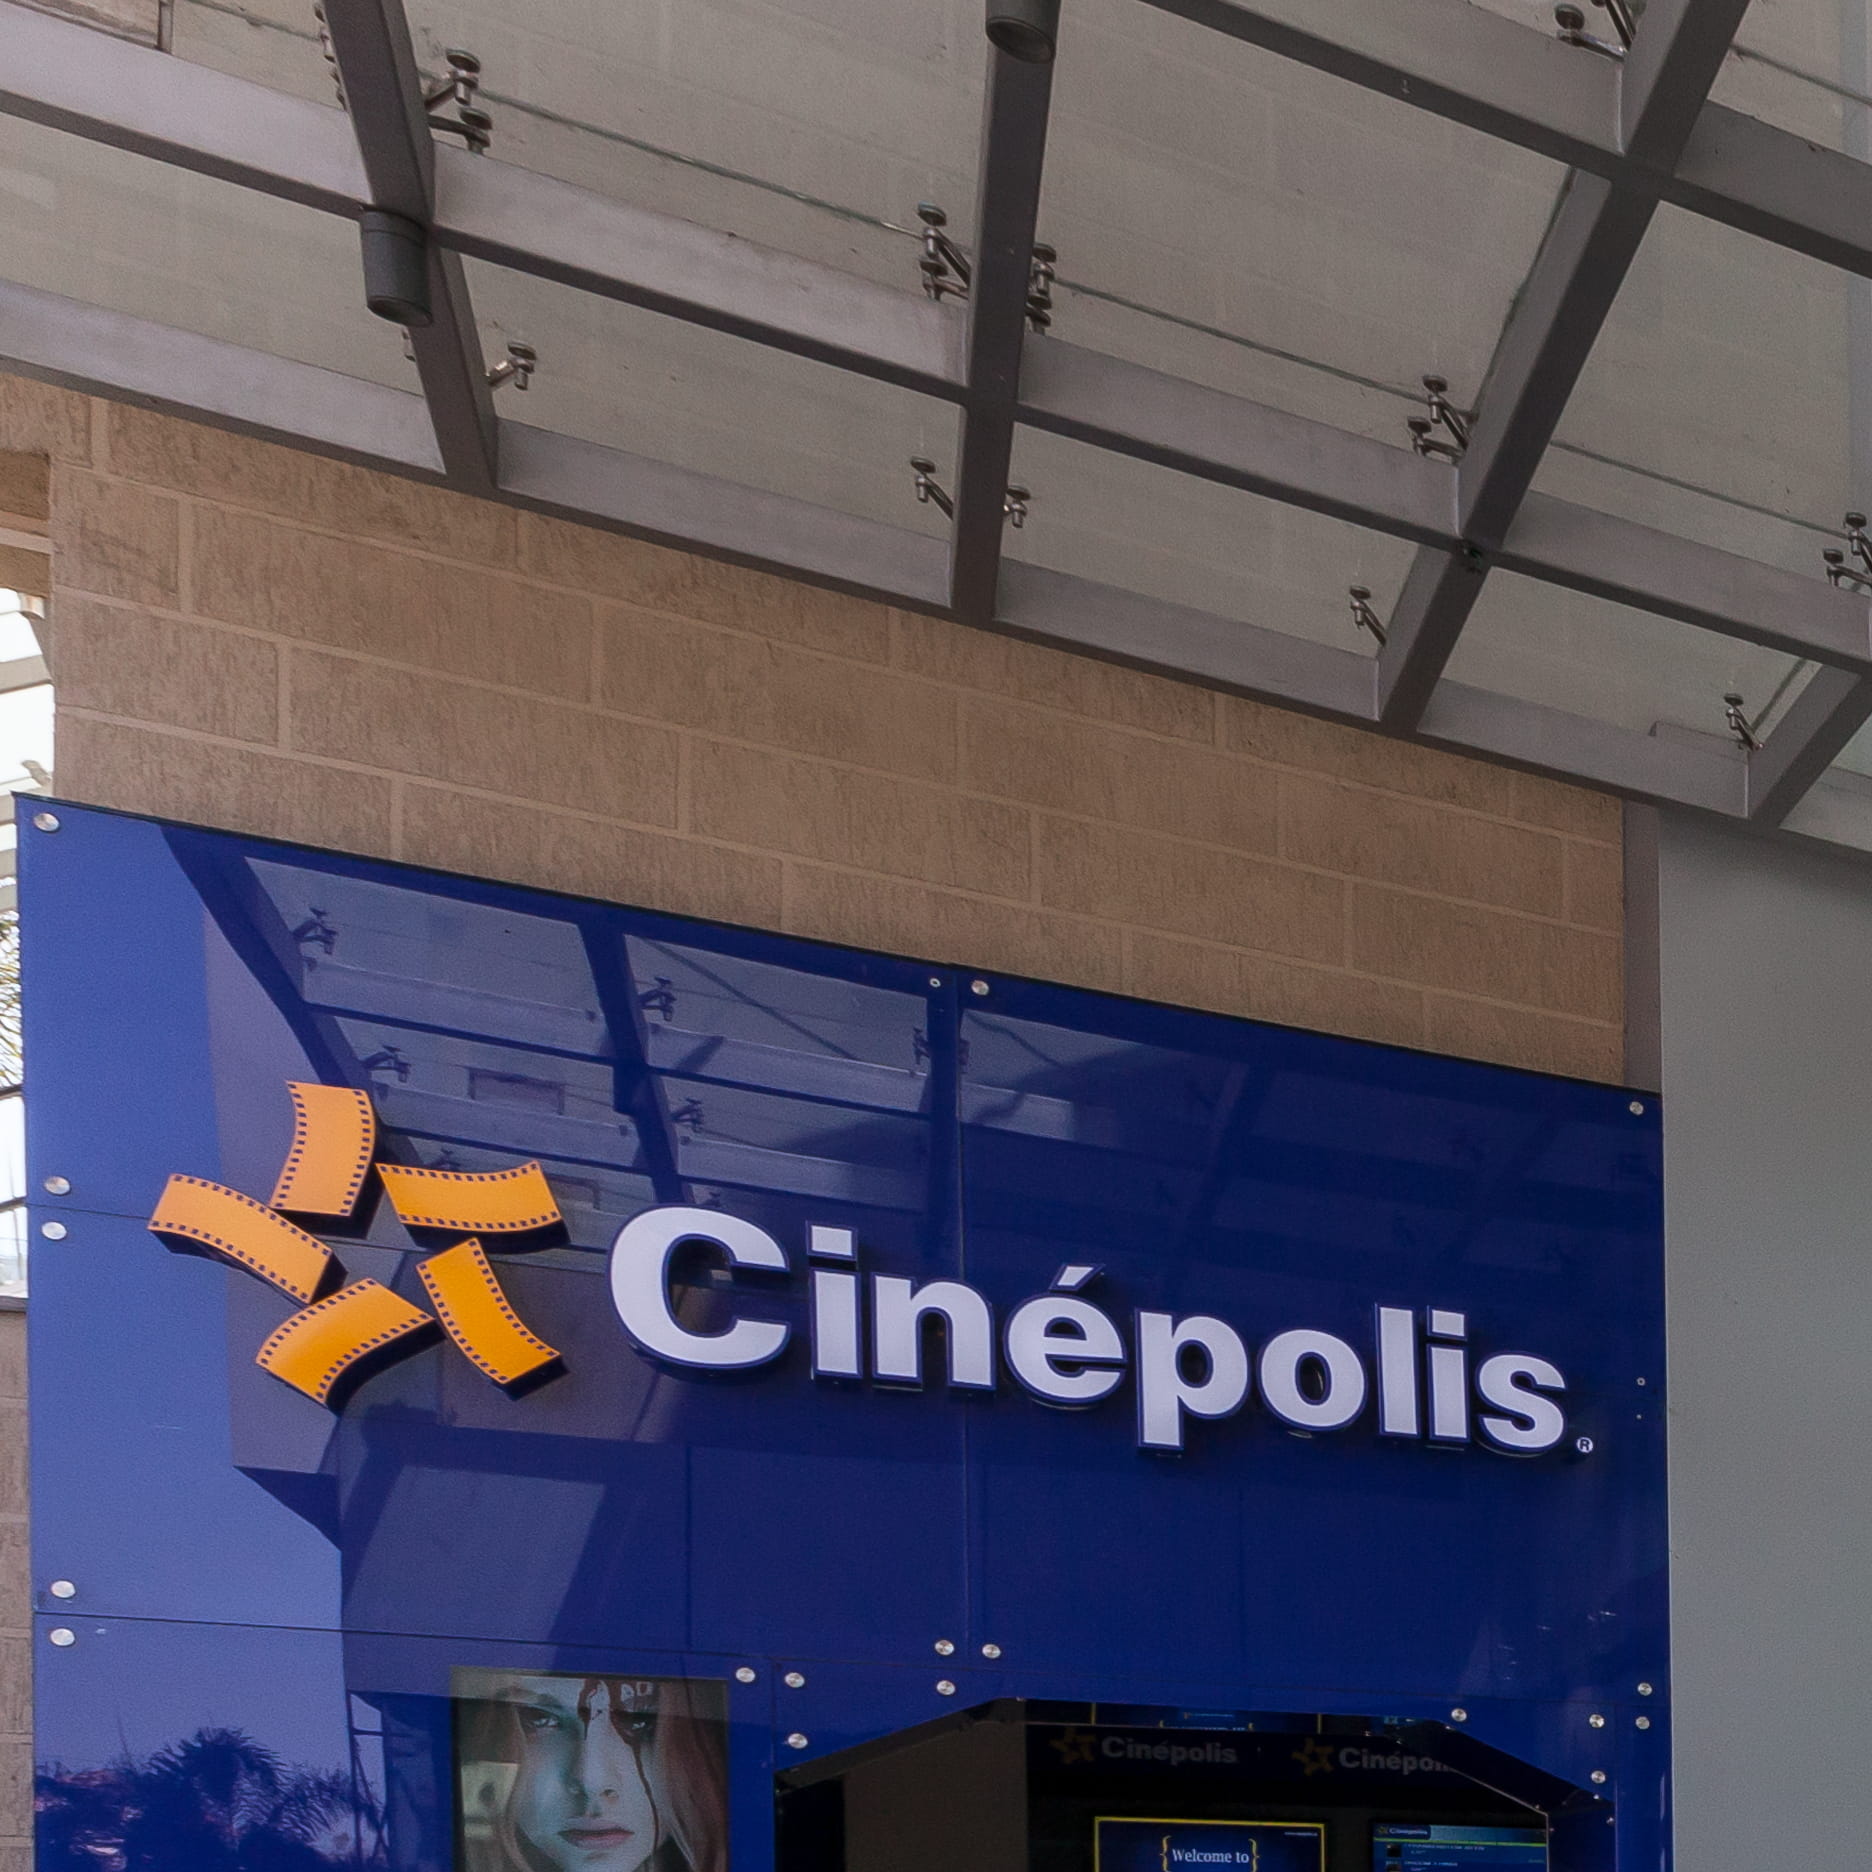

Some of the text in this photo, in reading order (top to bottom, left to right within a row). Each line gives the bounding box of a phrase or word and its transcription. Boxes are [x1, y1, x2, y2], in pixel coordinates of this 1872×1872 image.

[609, 1206, 1567, 1450] Cinépolis
[1102, 1734, 1238, 1767] Cinépolis
[1338, 1746, 1448, 1777] Cinépo
[1172, 1847, 1250, 1864] Welcome to
